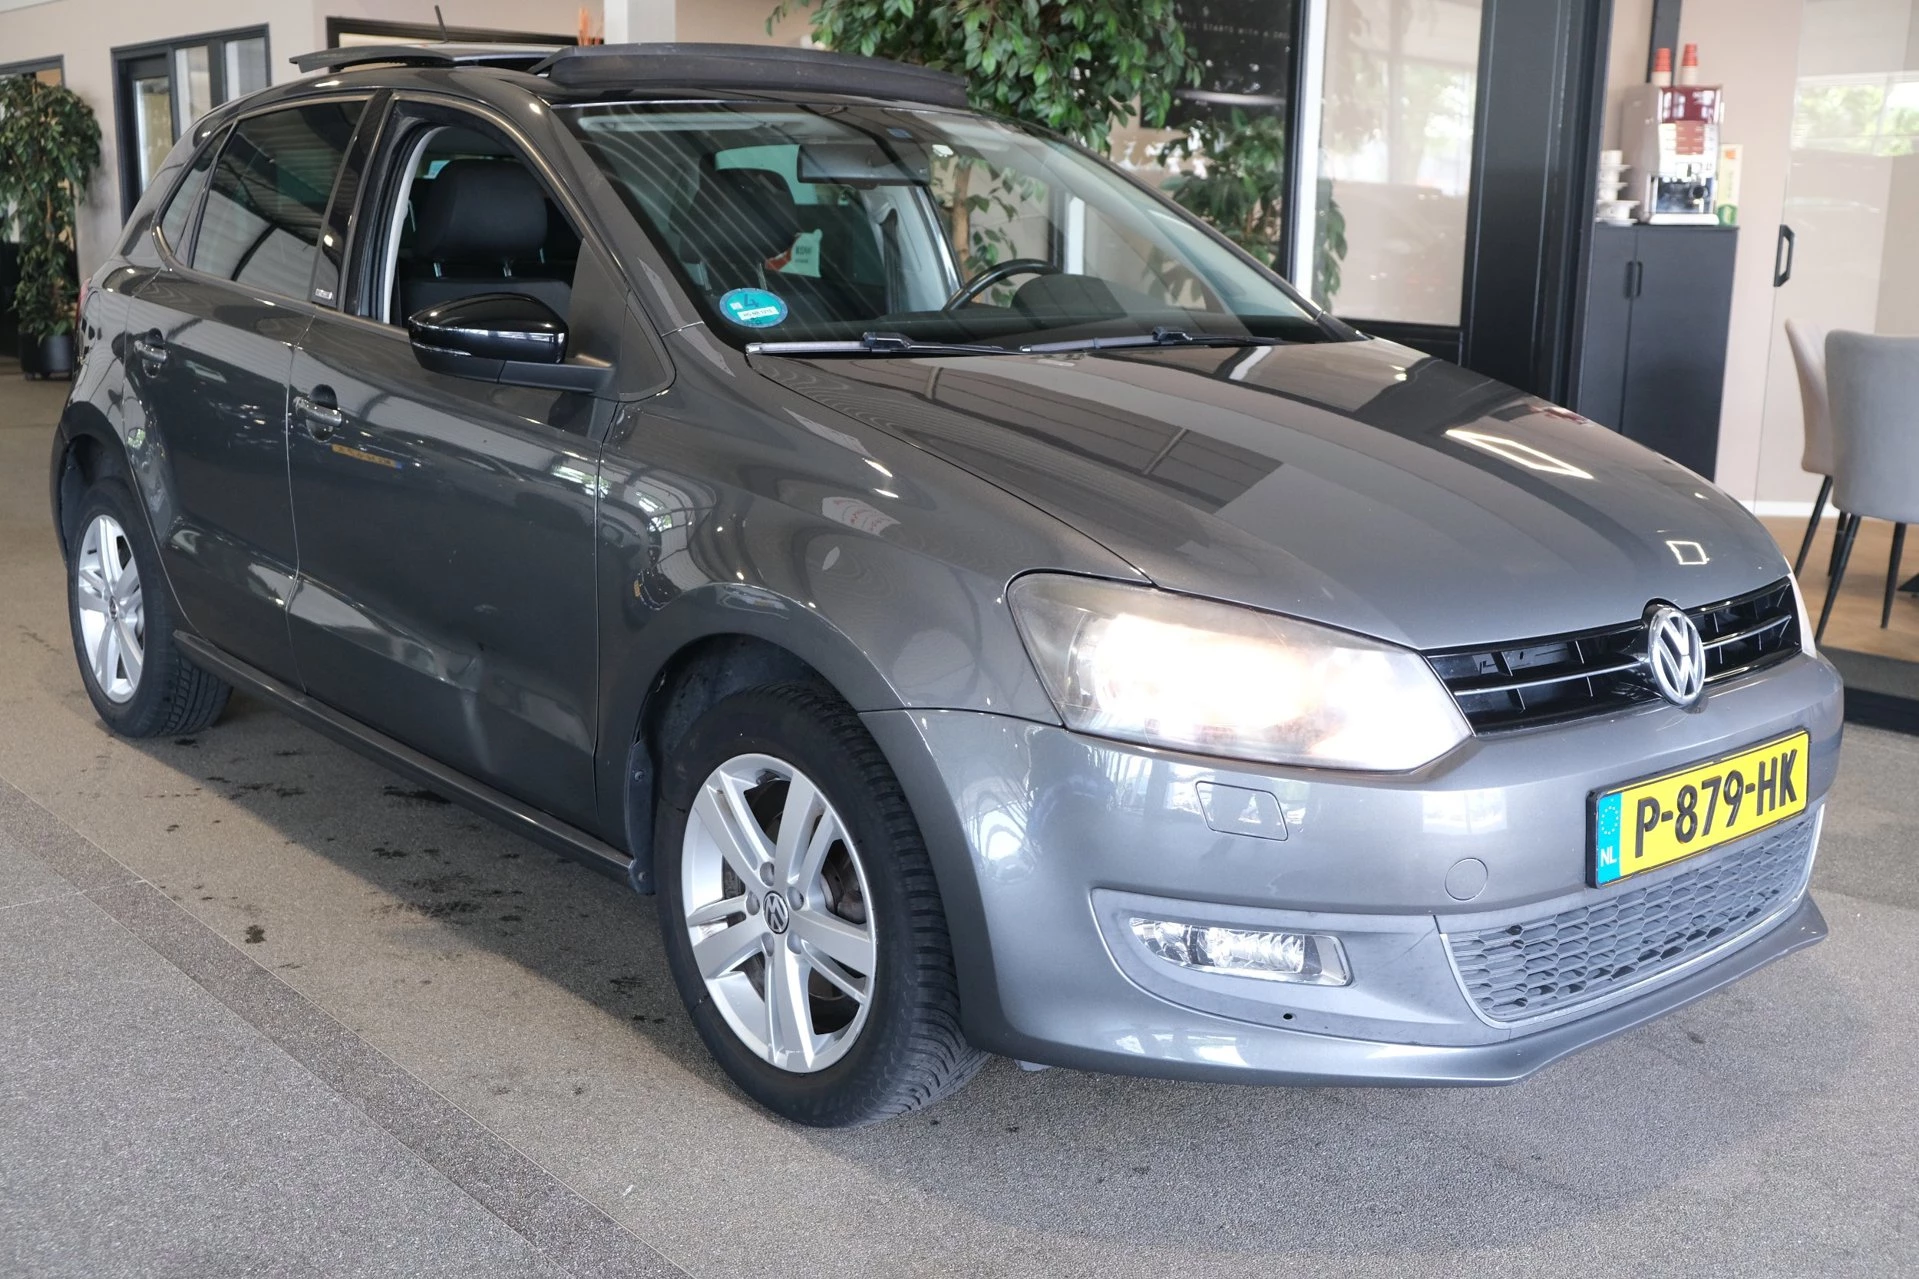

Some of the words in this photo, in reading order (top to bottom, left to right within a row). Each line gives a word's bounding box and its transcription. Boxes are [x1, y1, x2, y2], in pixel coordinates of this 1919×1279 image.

[743, 293, 759, 307] 4
[1635, 749, 1798, 859] P-879-HK
[1600, 846, 1617, 867] NL
